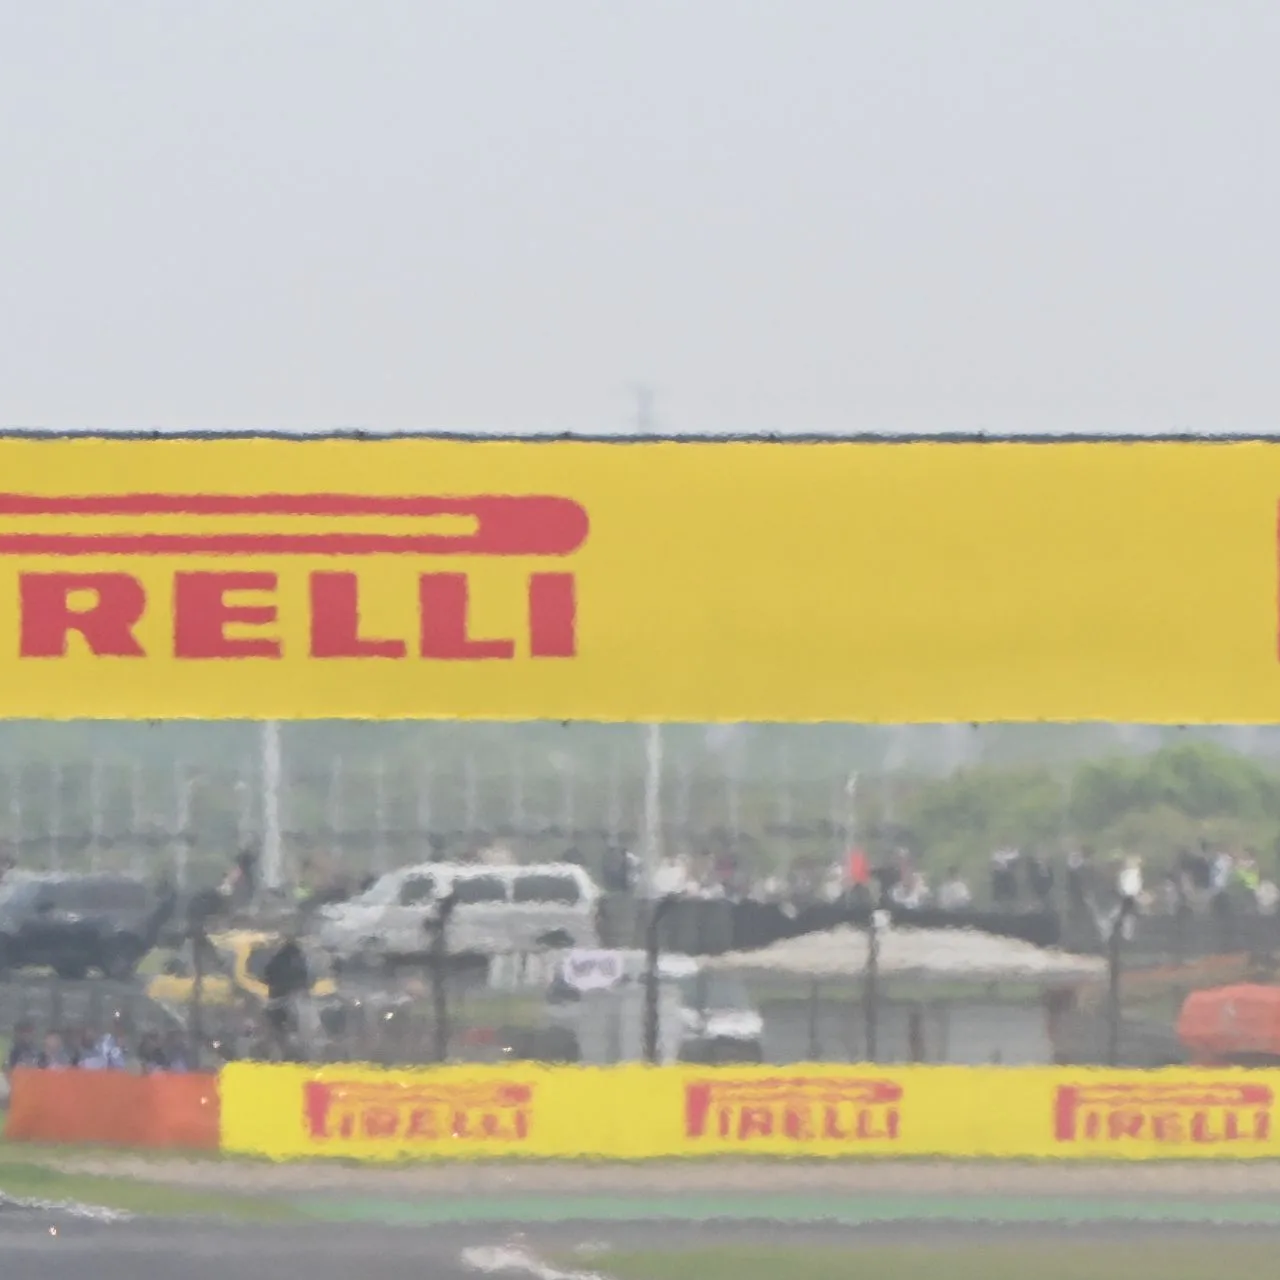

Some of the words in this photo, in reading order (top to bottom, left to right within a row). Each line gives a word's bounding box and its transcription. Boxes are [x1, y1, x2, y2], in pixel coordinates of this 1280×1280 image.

[303, 1079, 533, 1140] PIRELLI
[684, 1077, 904, 1141] PIRELLI
[1052, 1082, 1274, 1143] PIRELLI
